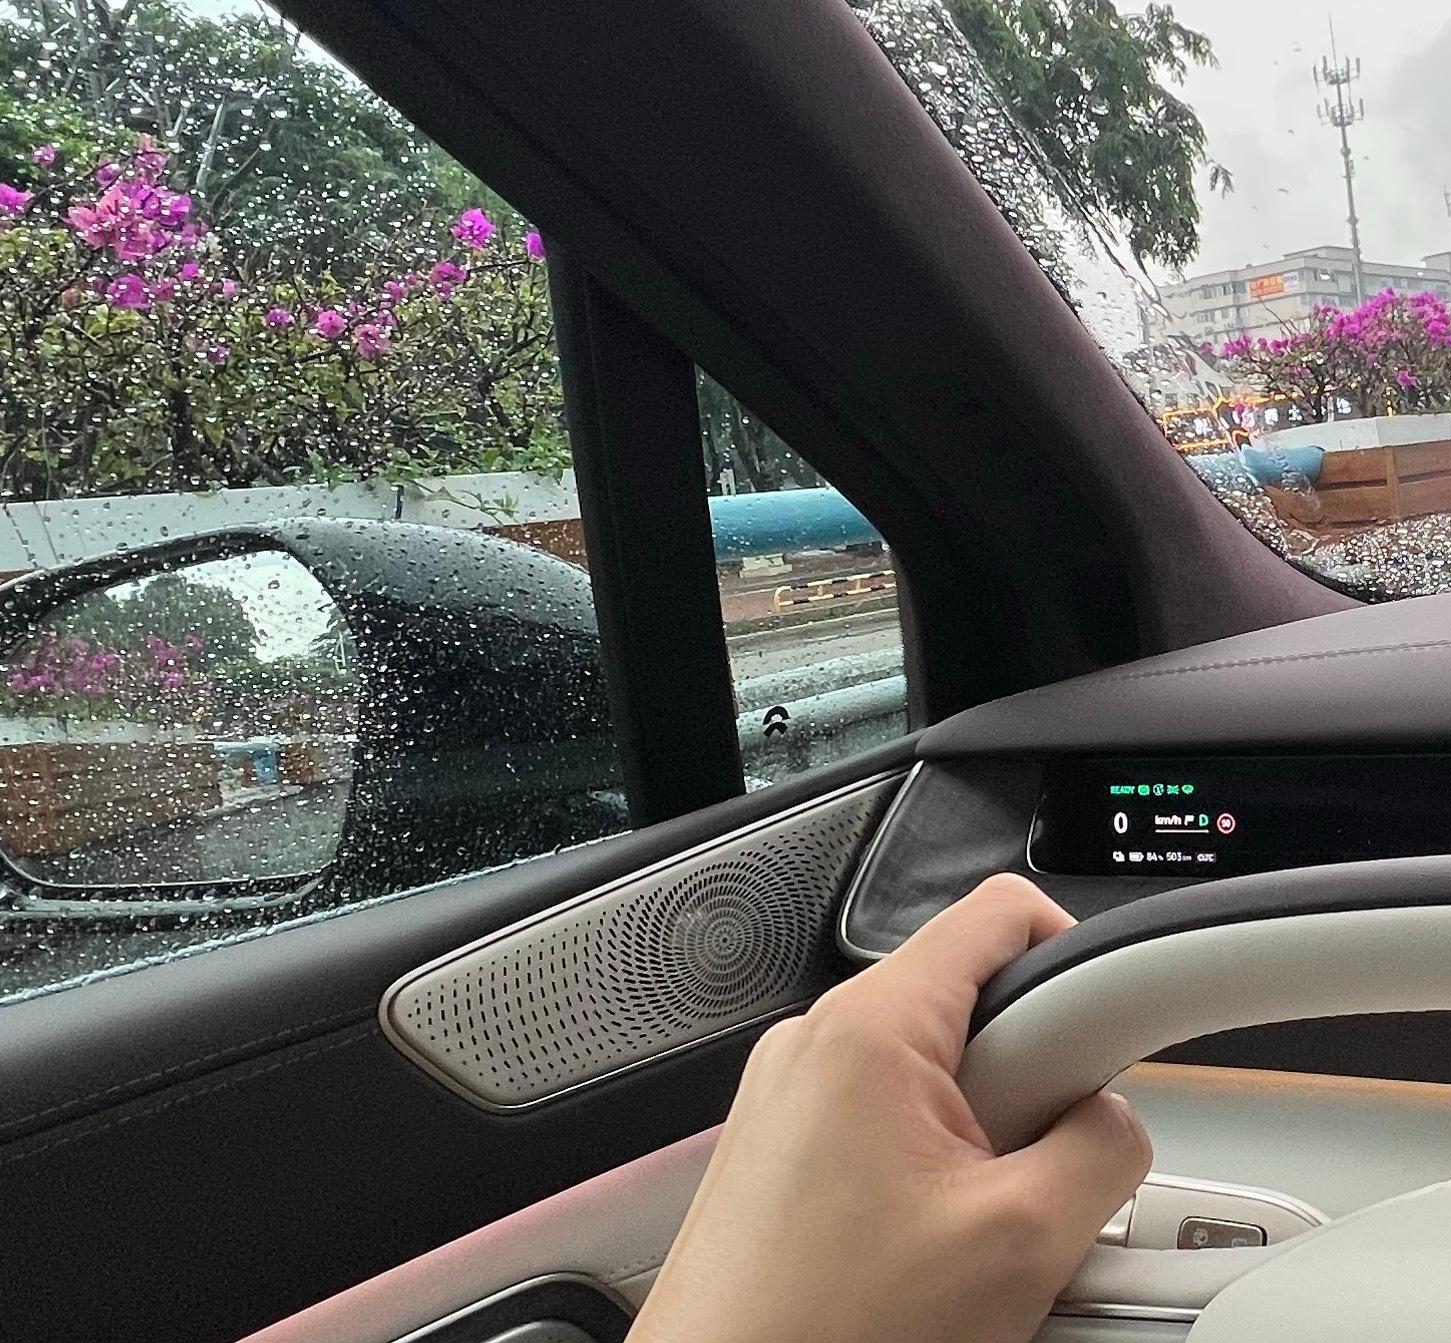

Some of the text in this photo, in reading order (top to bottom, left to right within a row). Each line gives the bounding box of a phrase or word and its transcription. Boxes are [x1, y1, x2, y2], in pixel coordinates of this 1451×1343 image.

[1113, 811, 1128, 834] 0
[1154, 815, 1182, 825] km/h
[1198, 813, 1209, 826] D
